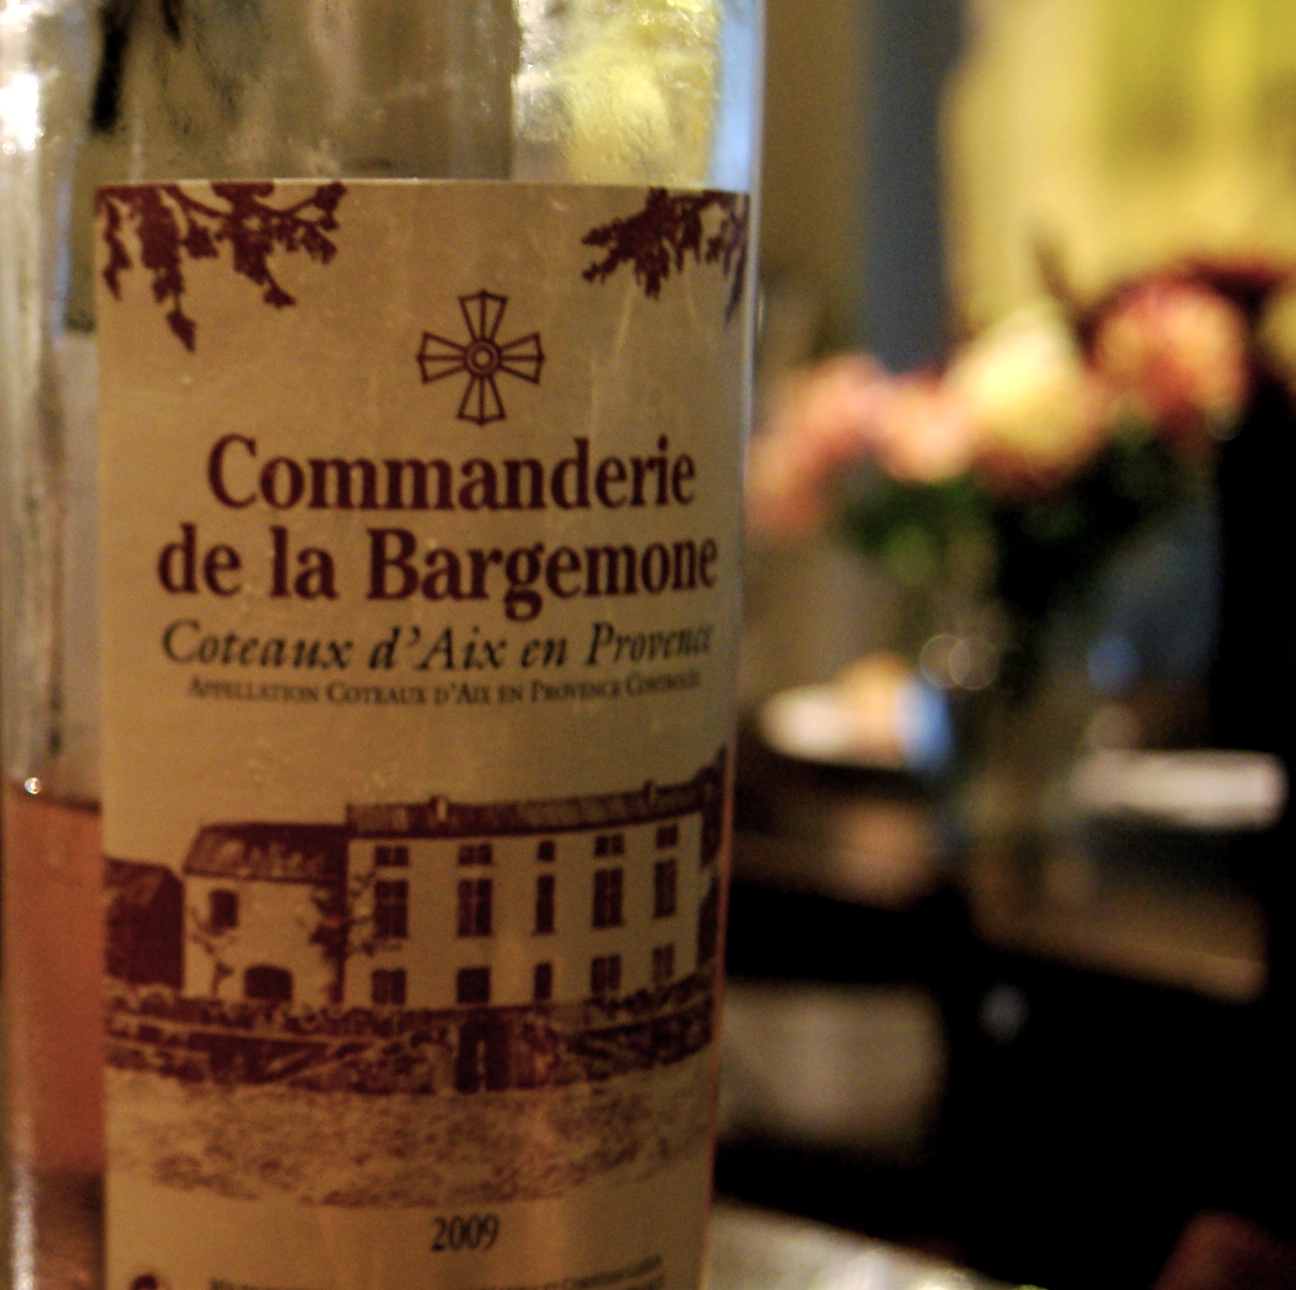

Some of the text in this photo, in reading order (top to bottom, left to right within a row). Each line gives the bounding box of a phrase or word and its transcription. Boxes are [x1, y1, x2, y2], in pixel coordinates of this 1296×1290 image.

[207, 433, 696, 511] Commanderie
[157, 522, 718, 623] de la Bargemone
[162, 618, 354, 670] Coteaux
[367, 624, 507, 671] d'Aix
[519, 636, 568, 668] en
[430, 1213, 501, 1252] 2009
